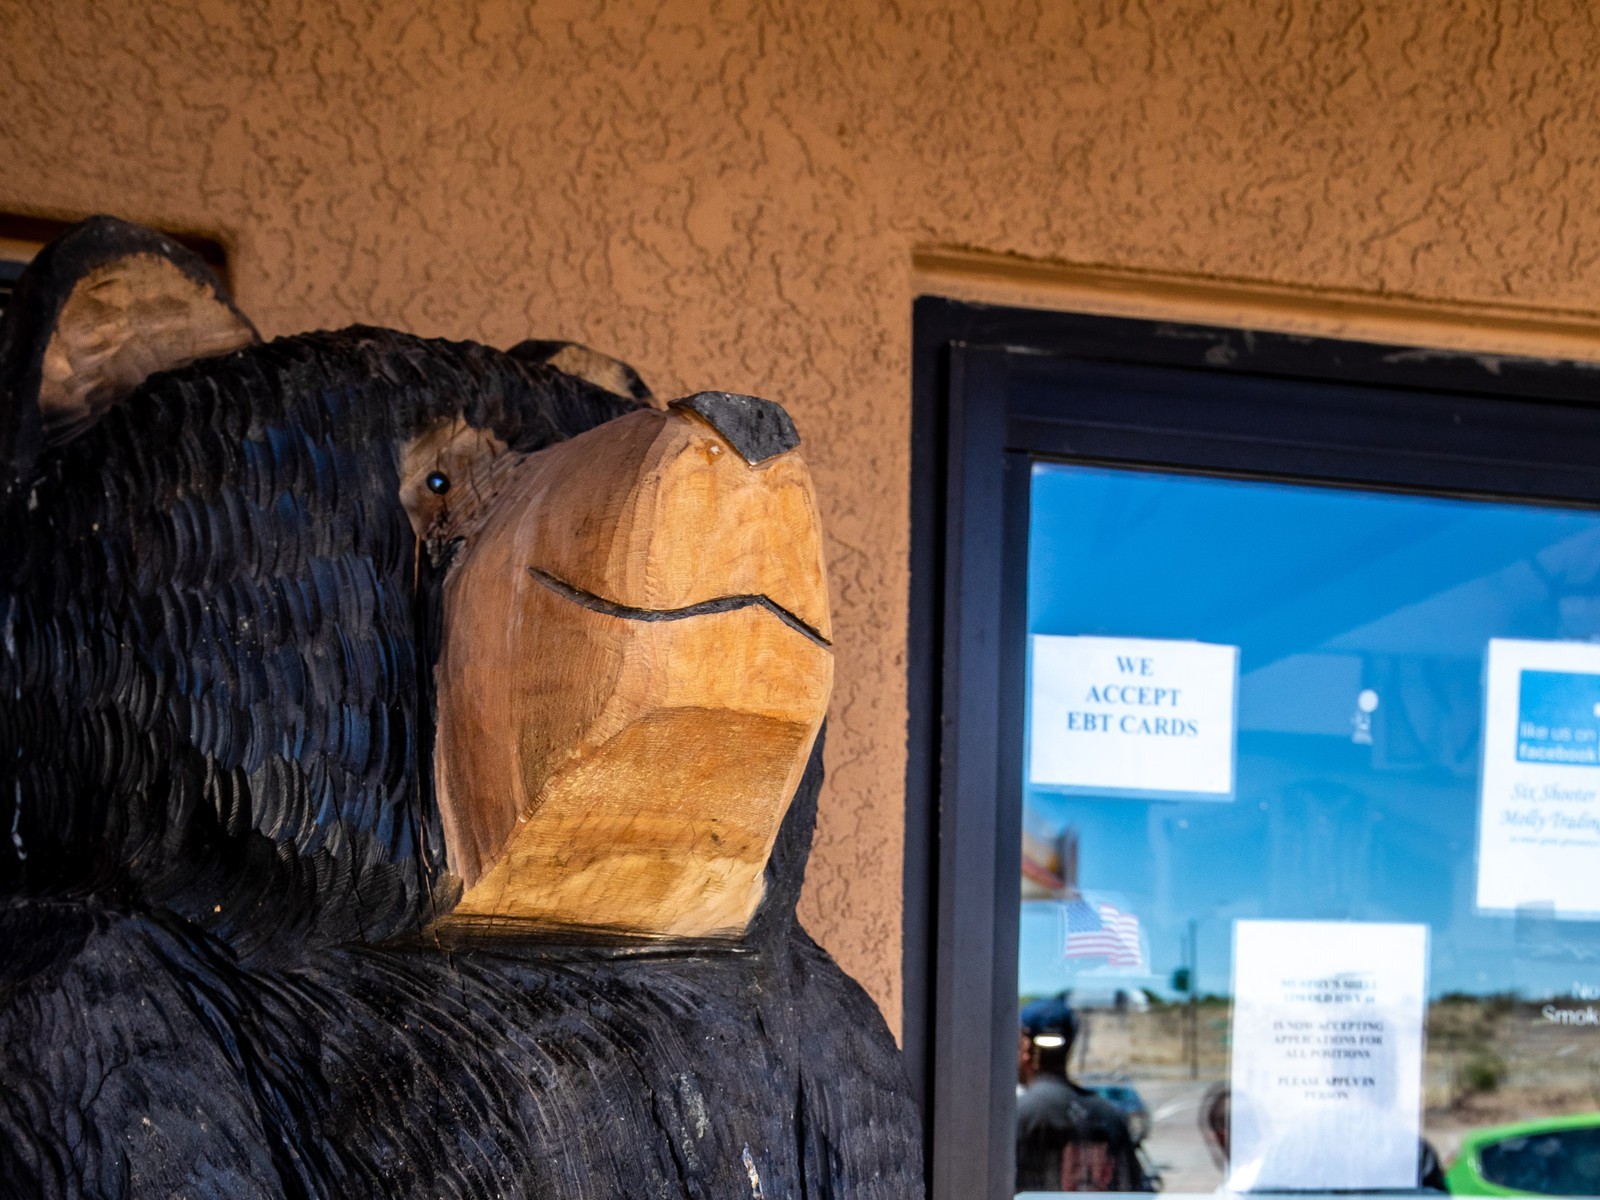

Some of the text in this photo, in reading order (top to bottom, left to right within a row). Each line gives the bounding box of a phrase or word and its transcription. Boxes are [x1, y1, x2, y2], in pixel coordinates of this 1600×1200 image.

[1116, 655, 1154, 676] WE
[1086, 684, 1181, 707] ACCEPT
[1067, 711, 1199, 737] EBT CARDS
[1519, 741, 1597, 762] facebook
[1319, 1020, 1384, 1032] ACCEPTING
[1311, 1049, 1371, 1060] POSITIONS
